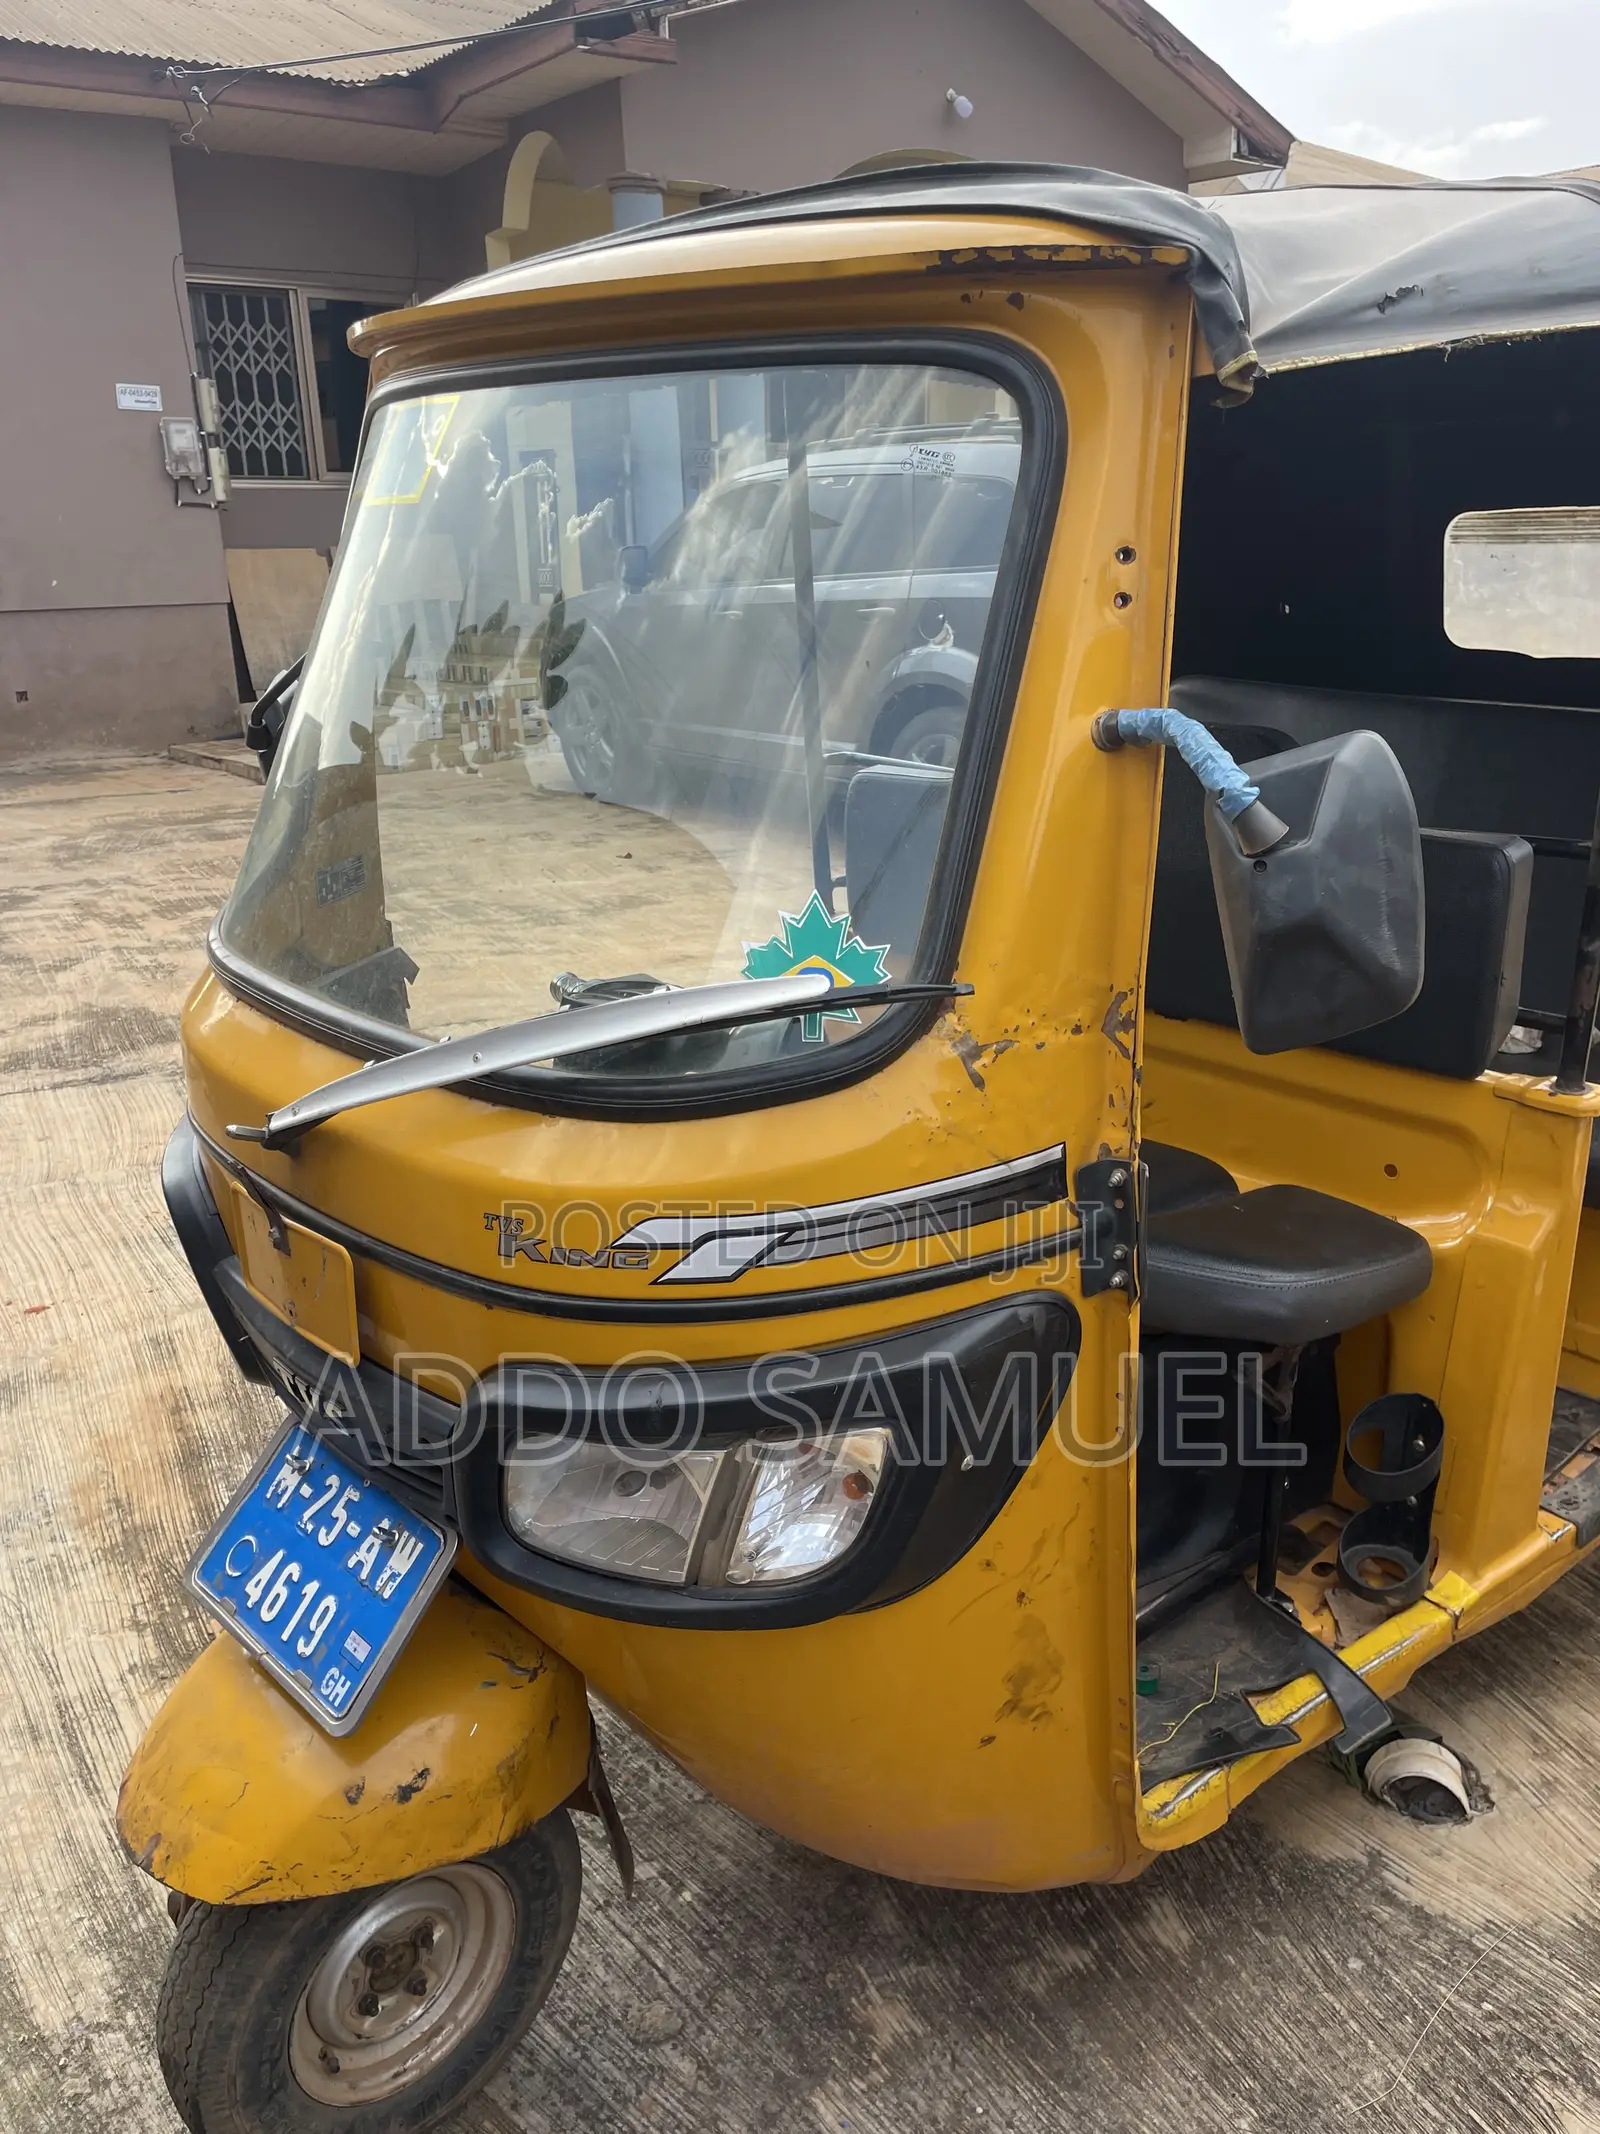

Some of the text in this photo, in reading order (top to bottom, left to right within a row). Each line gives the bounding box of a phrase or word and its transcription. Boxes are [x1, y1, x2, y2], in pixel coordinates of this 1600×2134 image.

[484, 1213, 524, 1236] TVS
[244, 1549, 337, 1658] 4619
[320, 1666, 352, 1708] GH
